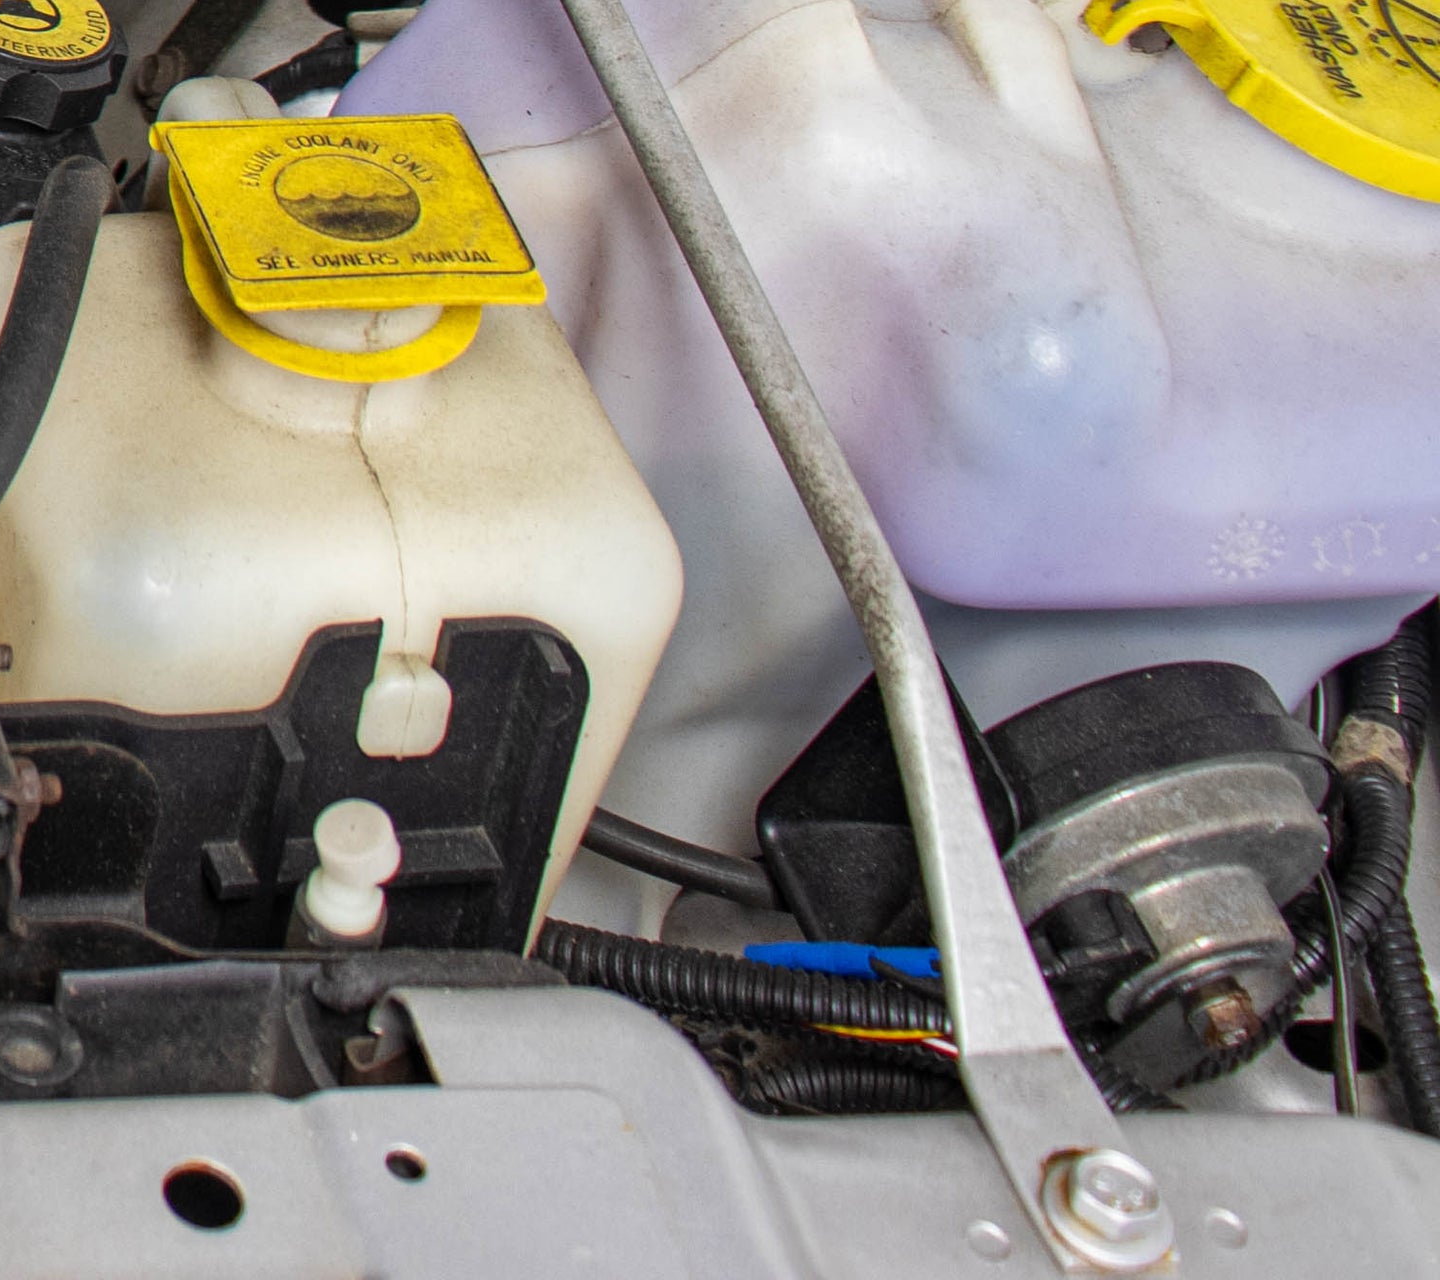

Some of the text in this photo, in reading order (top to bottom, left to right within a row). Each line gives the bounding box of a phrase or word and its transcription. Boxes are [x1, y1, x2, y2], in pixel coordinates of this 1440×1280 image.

[80, 8, 106, 48] FLUID
[1280, 1, 1363, 100] WASHER
[239, 132, 435, 190] ENGINE COOLANT ONLY
[256, 249, 499, 272] SEE OWNERS MANUAL
